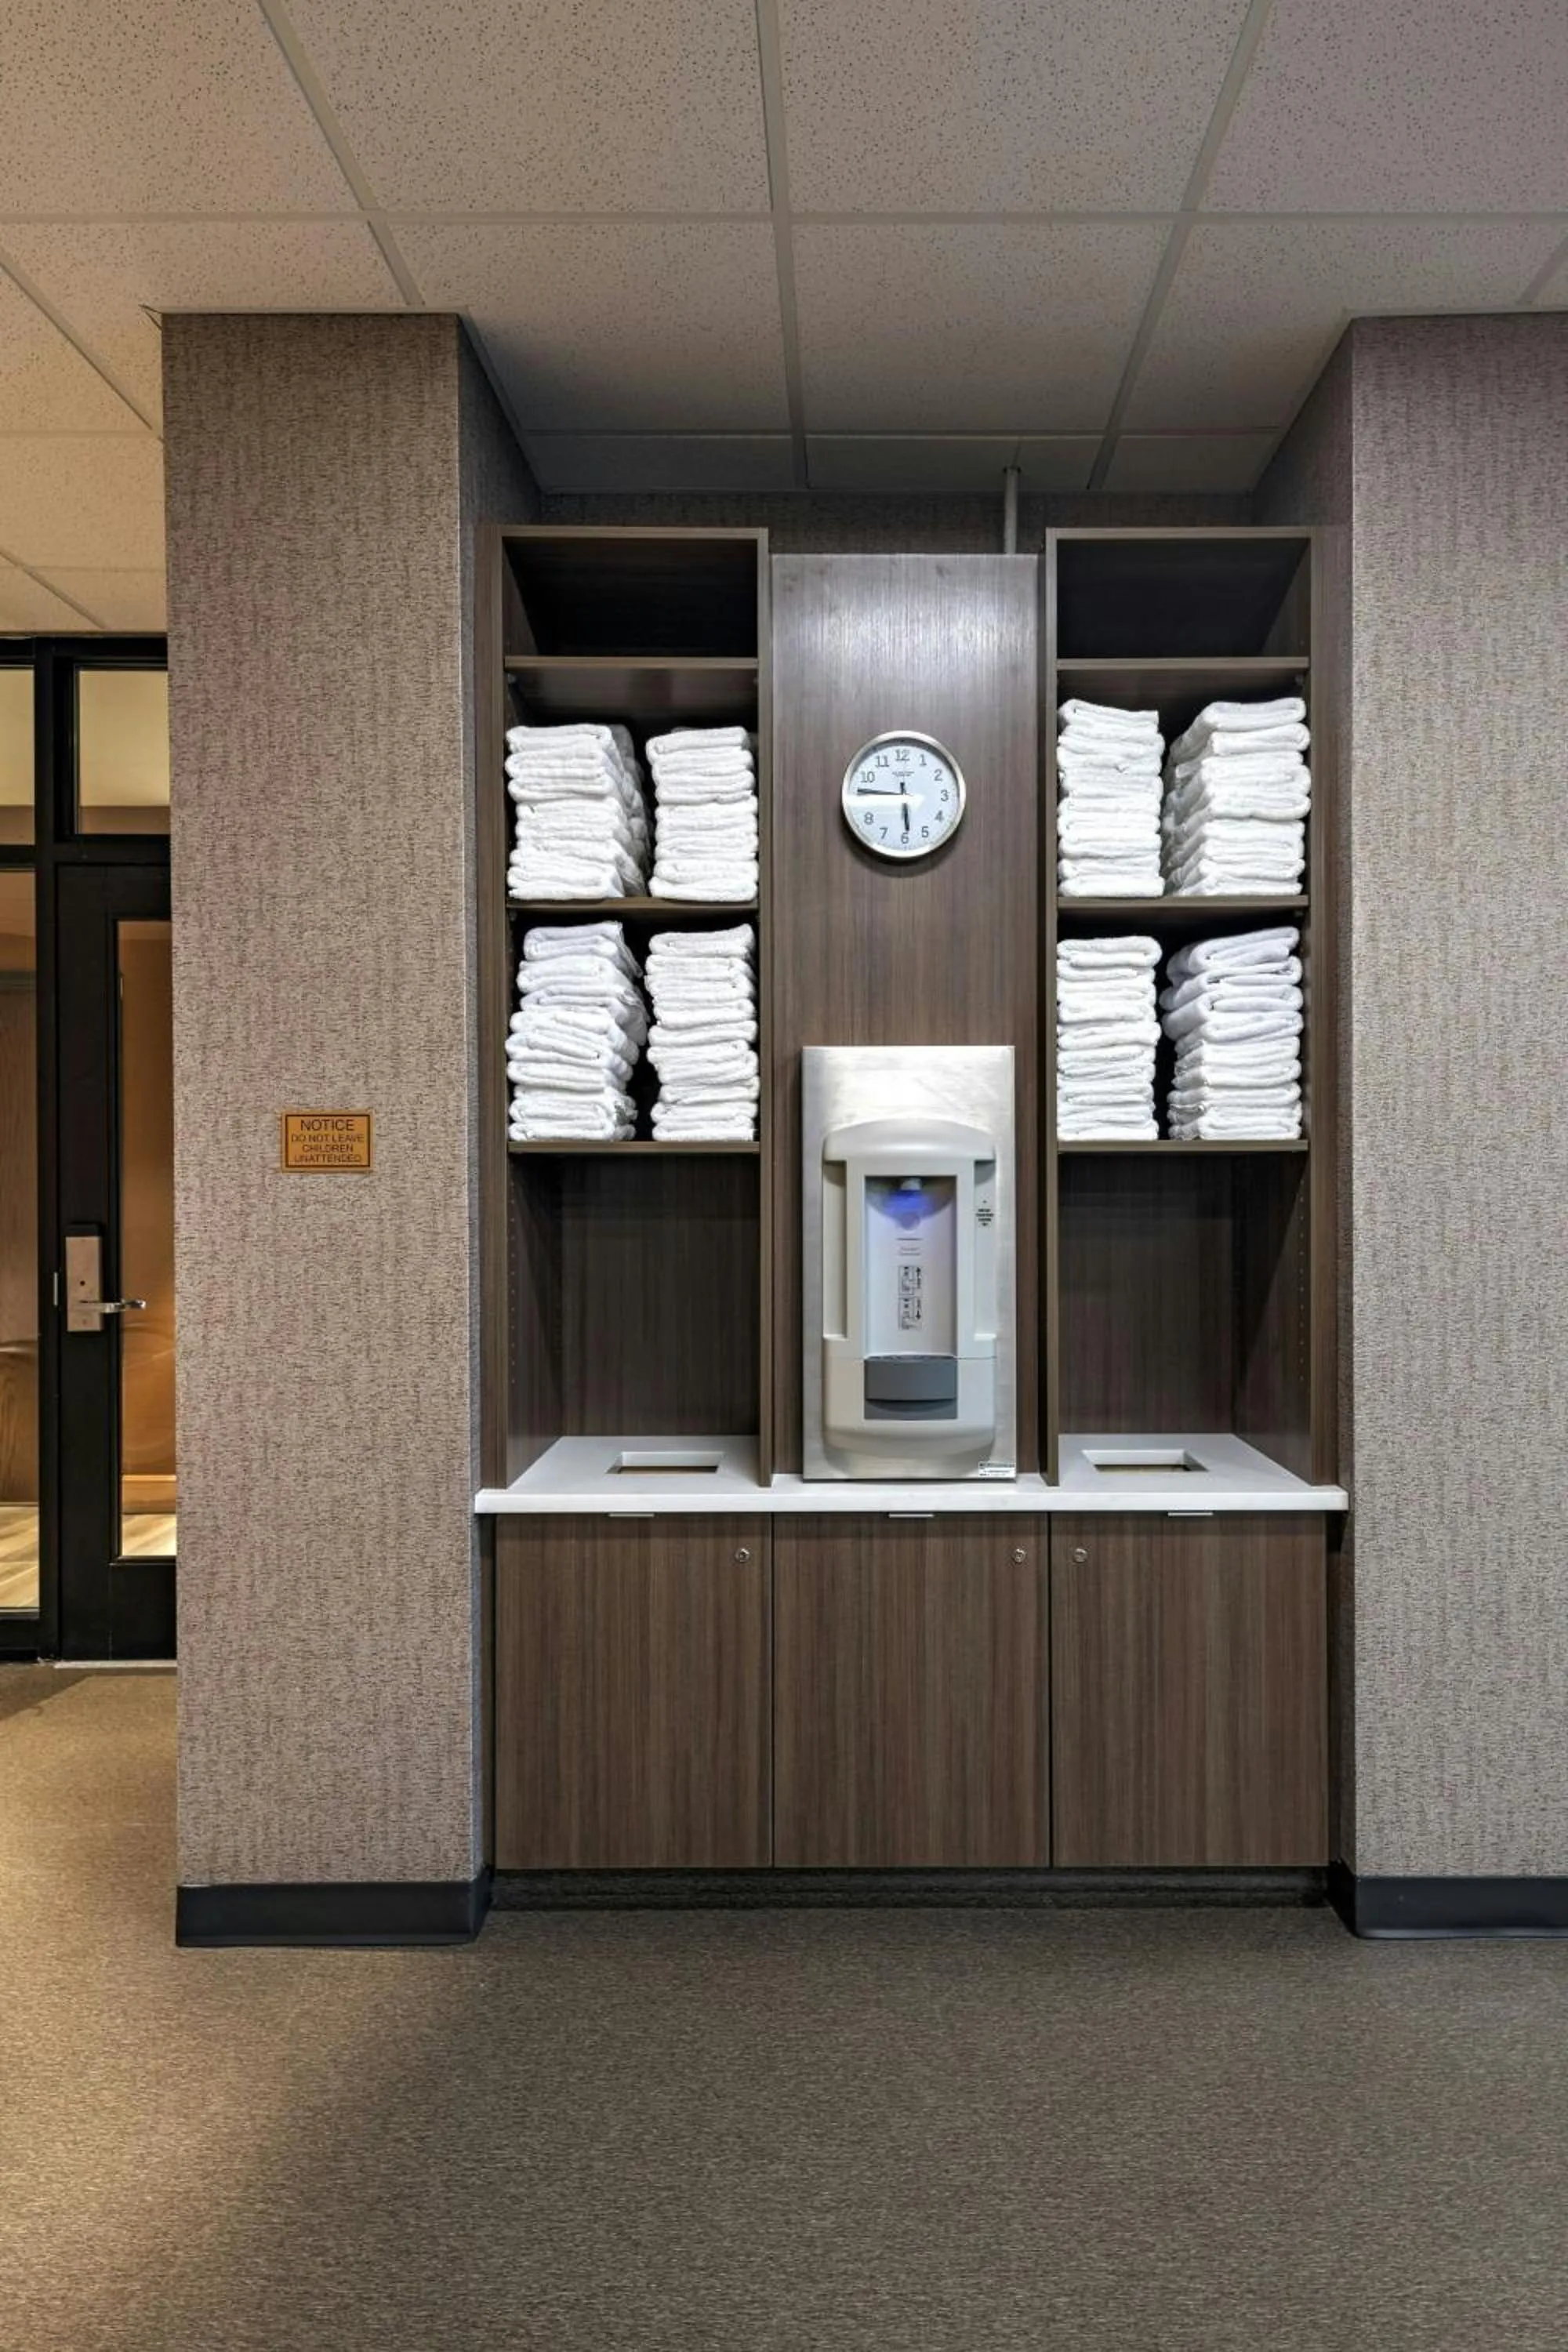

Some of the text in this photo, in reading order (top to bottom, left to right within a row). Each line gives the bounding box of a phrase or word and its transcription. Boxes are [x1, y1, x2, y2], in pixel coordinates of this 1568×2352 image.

[875, 756, 890, 767] 11
[895, 750, 909, 761] 12
[920, 754, 927, 766] 1
[860, 771, 875, 783] 10
[934, 769, 943, 781] 2
[941, 789, 949, 801] 3
[864, 812, 874, 825] 8
[935, 811, 944, 822] 4
[880, 827, 888, 839] 7
[901, 832, 909, 844] 6
[921, 826, 929, 838] 5
[300, 1119, 354, 1131] NOTICE
[292, 1134, 364, 1142] DO NOT LEAVE
